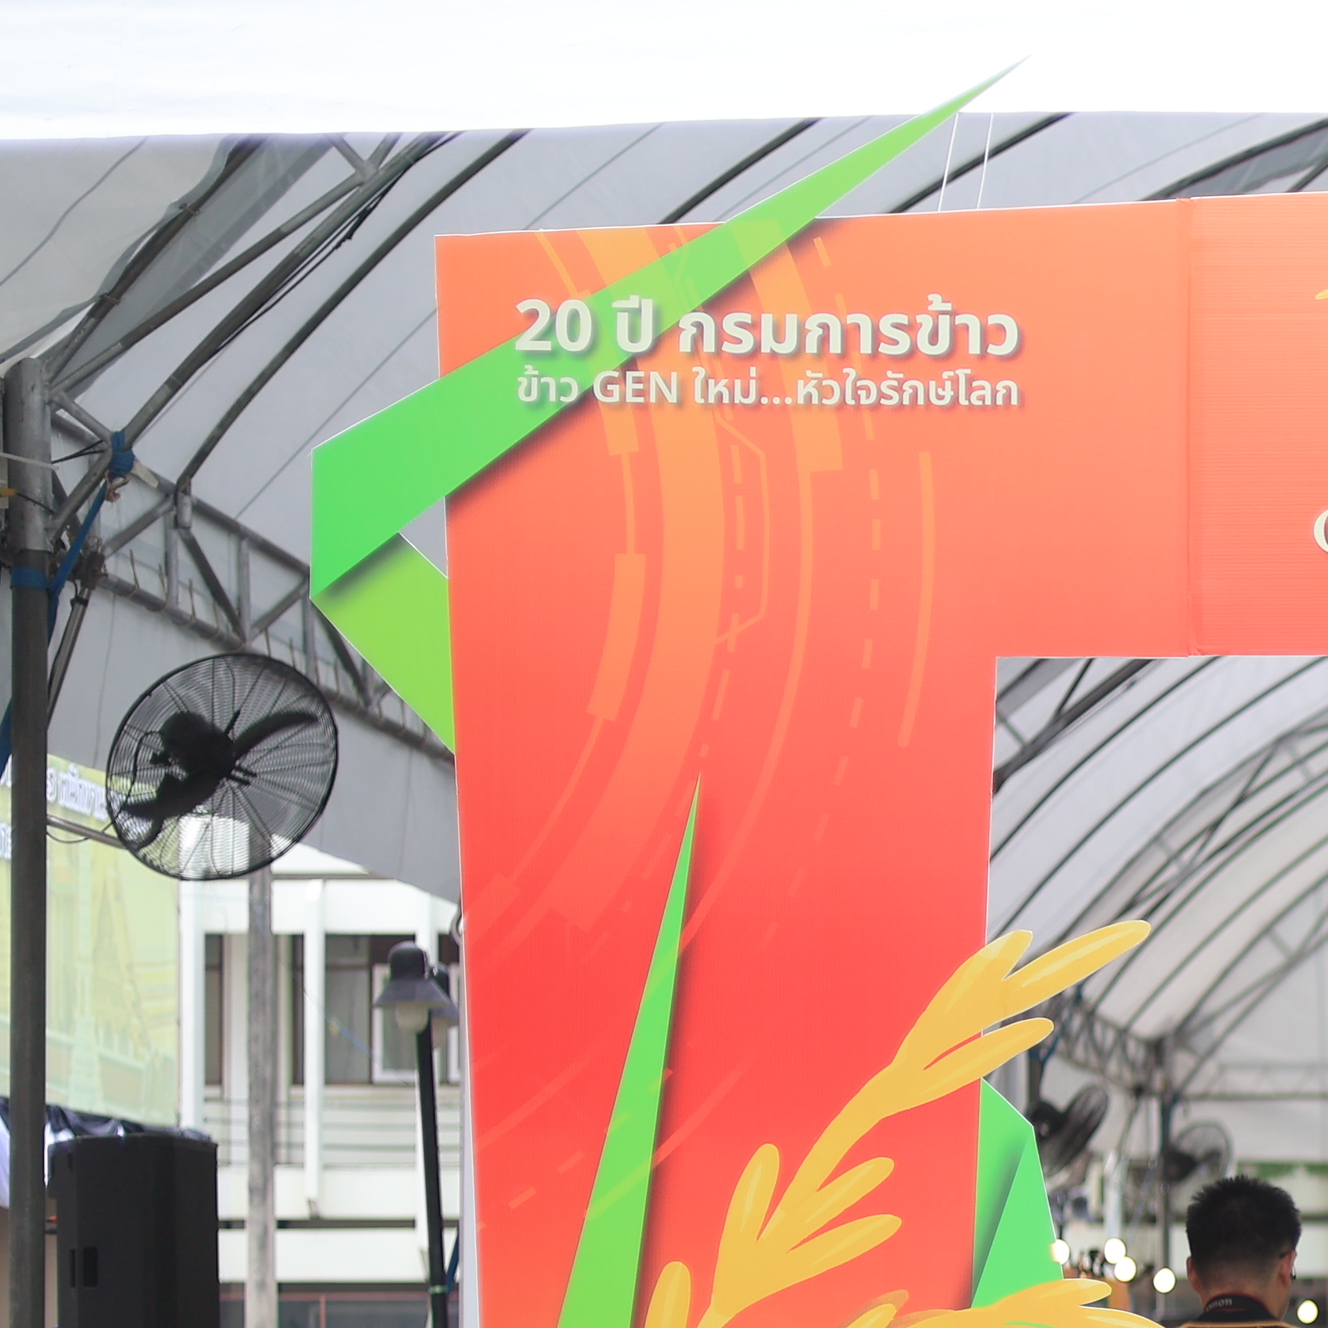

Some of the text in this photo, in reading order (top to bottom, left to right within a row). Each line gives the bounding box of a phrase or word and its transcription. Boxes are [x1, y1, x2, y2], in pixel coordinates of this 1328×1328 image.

[514, 293, 1020, 356] 20 ปี กรมการข้าว
[516, 363, 582, 404] ข้าว
[592, 370, 679, 404] GEN
